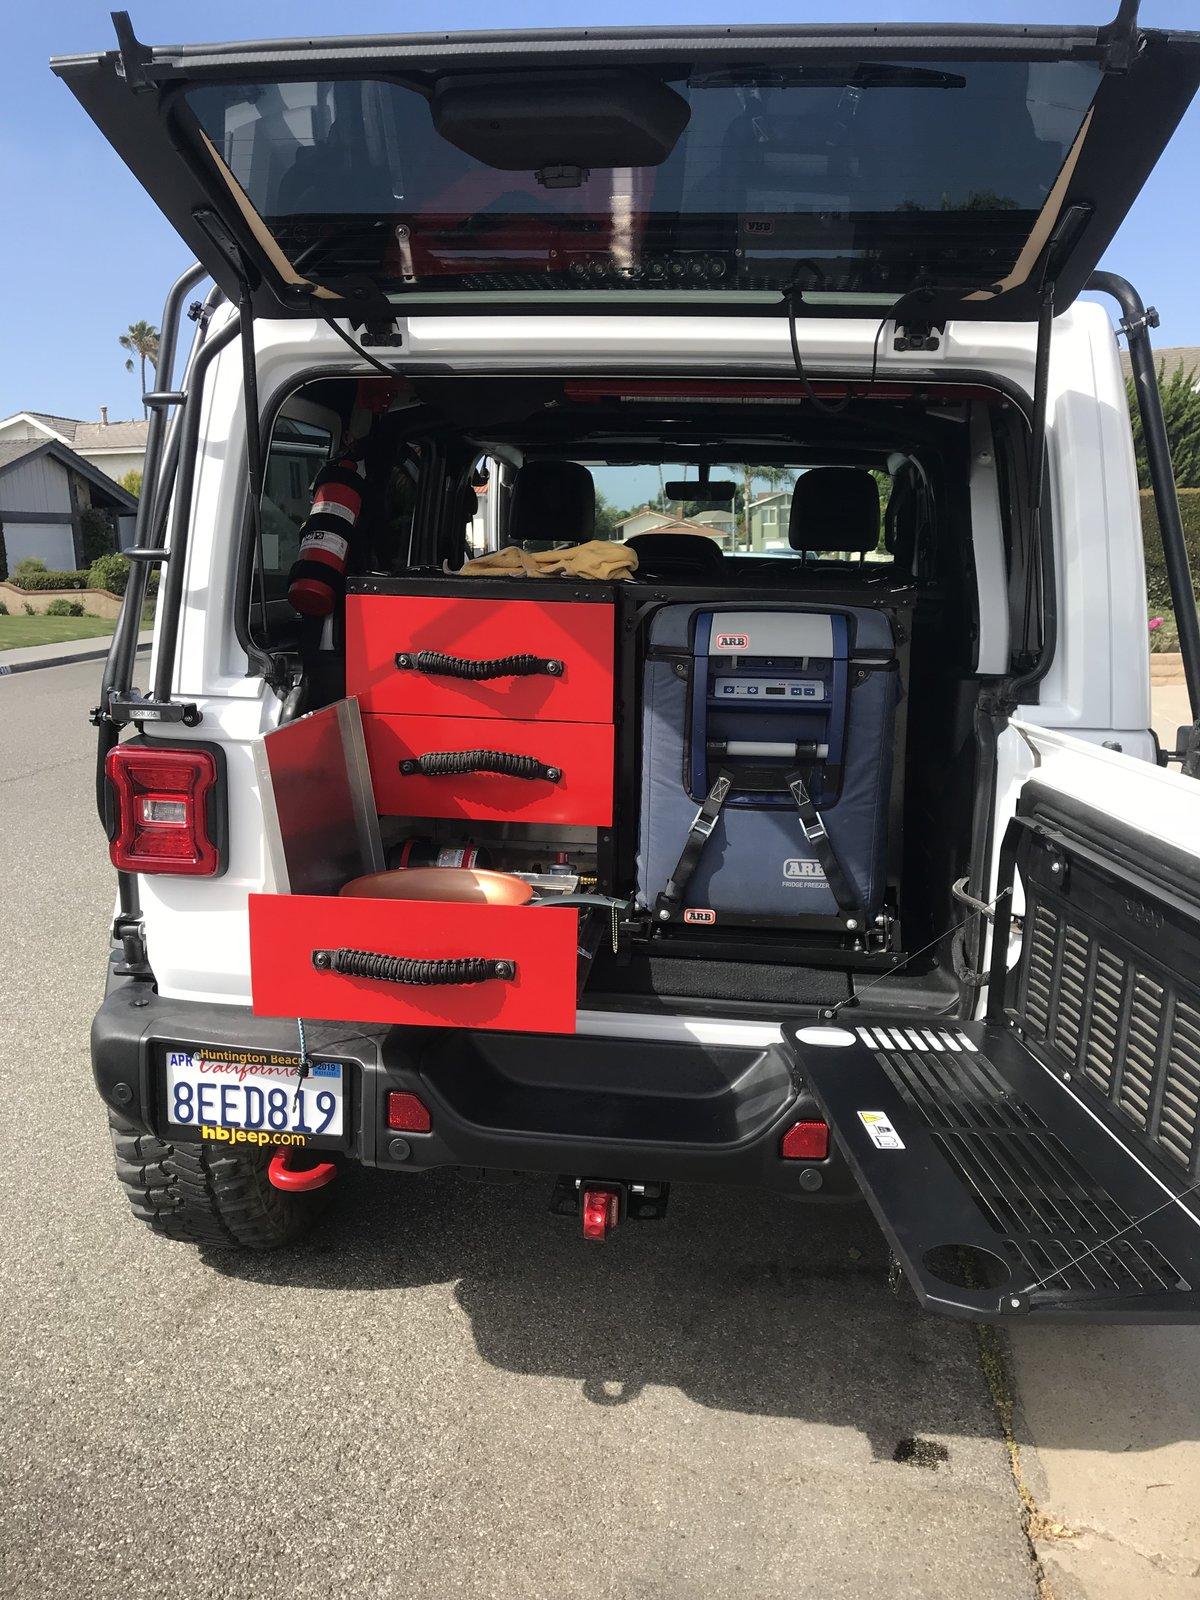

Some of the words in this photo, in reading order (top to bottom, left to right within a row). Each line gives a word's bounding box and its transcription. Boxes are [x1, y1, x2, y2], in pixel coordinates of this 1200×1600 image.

[720, 637, 745, 646] ARB
[787, 861, 826, 876] ARB
[689, 912, 711, 921] ARB
[170, 1054, 193, 1067] APR
[200, 1049, 267, 1064] Huntington
[271, 1055, 304, 1066] Beac
[317, 1063, 336, 1072] 2019
[173, 1081, 337, 1134] 8EED819
[202, 1125, 306, 1147] hbjeep.com
